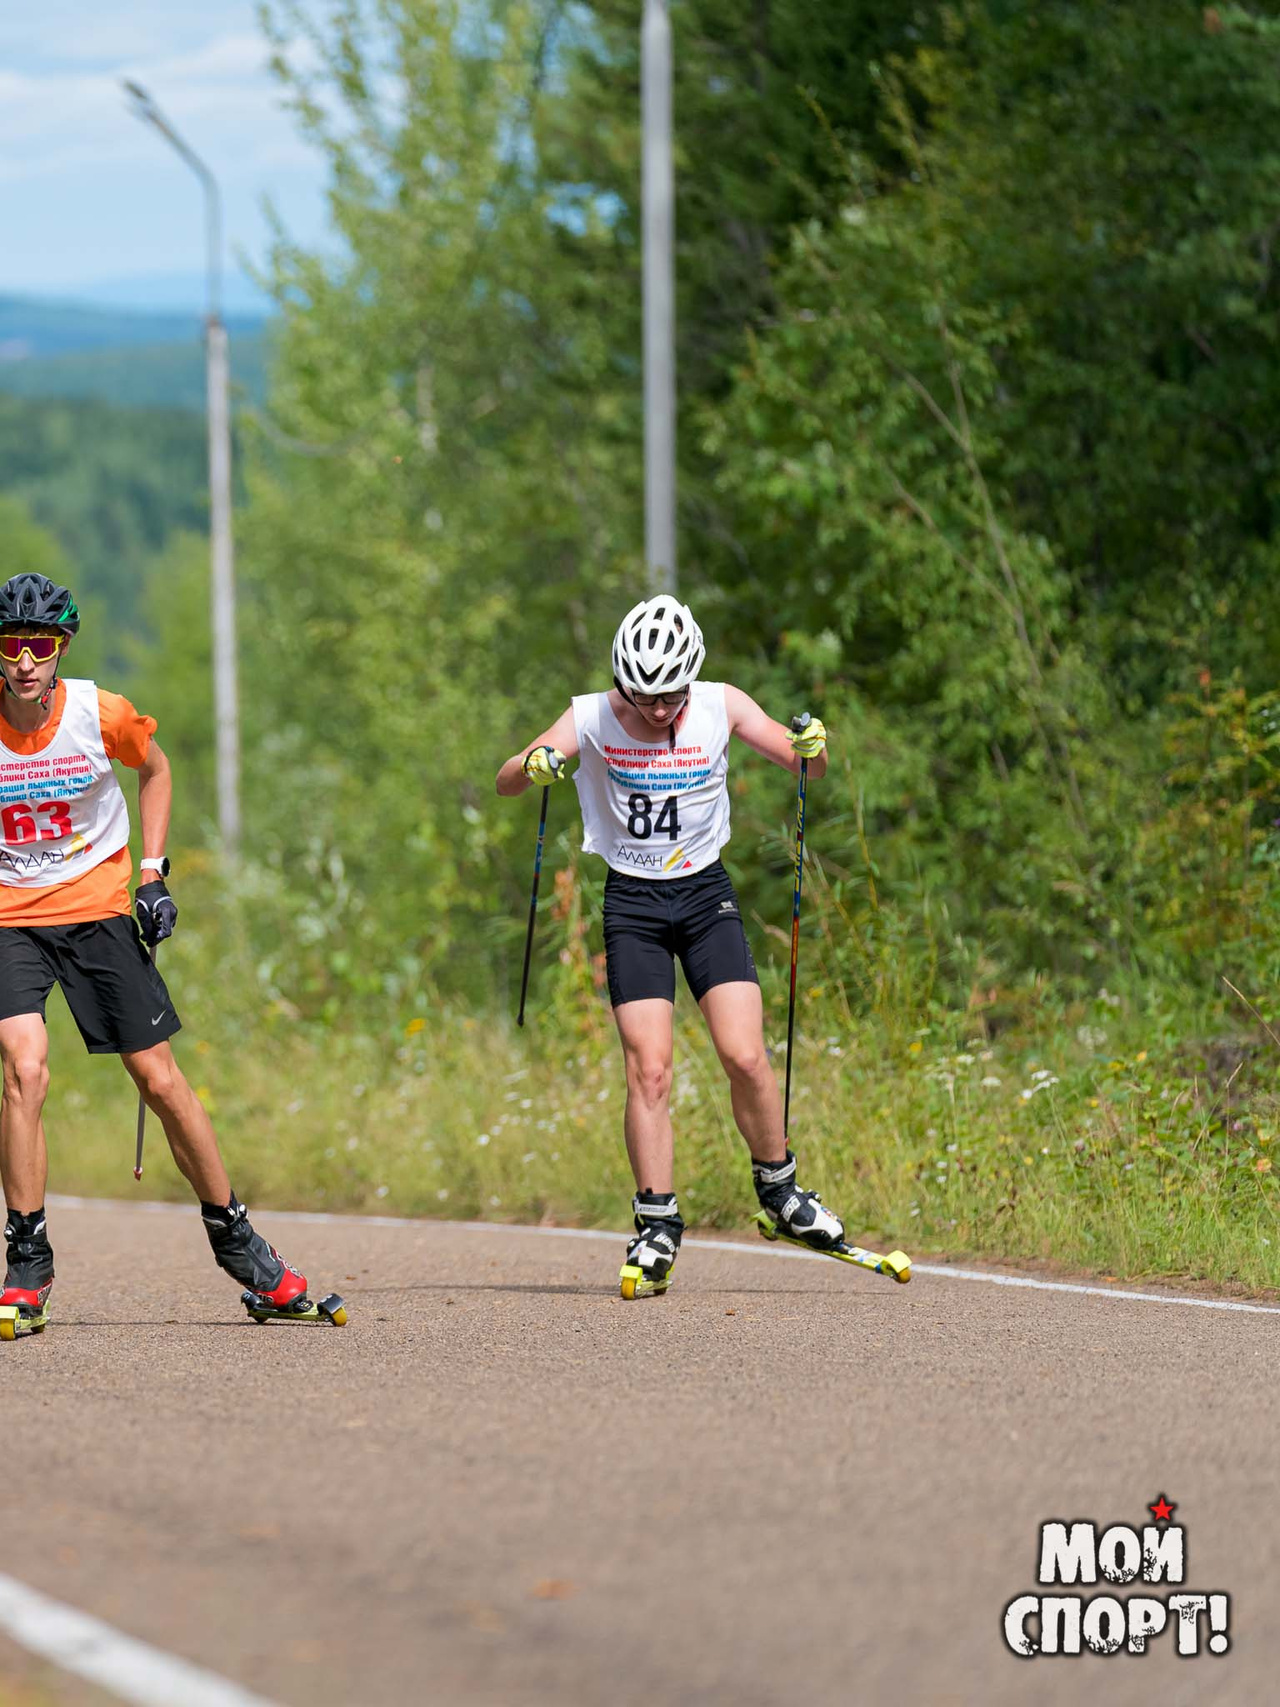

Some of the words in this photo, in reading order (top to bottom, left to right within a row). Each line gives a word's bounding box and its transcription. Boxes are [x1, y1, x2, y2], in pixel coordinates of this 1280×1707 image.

[604, 745, 669, 757] Министерство
[671, 746, 702, 756] спорта
[52, 754, 86, 766] спорта
[604, 757, 650, 769] спублики
[651, 759, 672, 769] Саха
[673, 756, 710, 768] (Якутия)
[27, 770, 50, 780] Саха
[52, 763, 92, 778] (Якутия)
[647, 773, 688, 781] лыжных
[27, 779, 66, 790] лыжных
[651, 783, 672, 791] Саха
[29, 791, 51, 800] Саха
[627, 793, 682, 841] 84
[1, 801, 73, 846] 63
